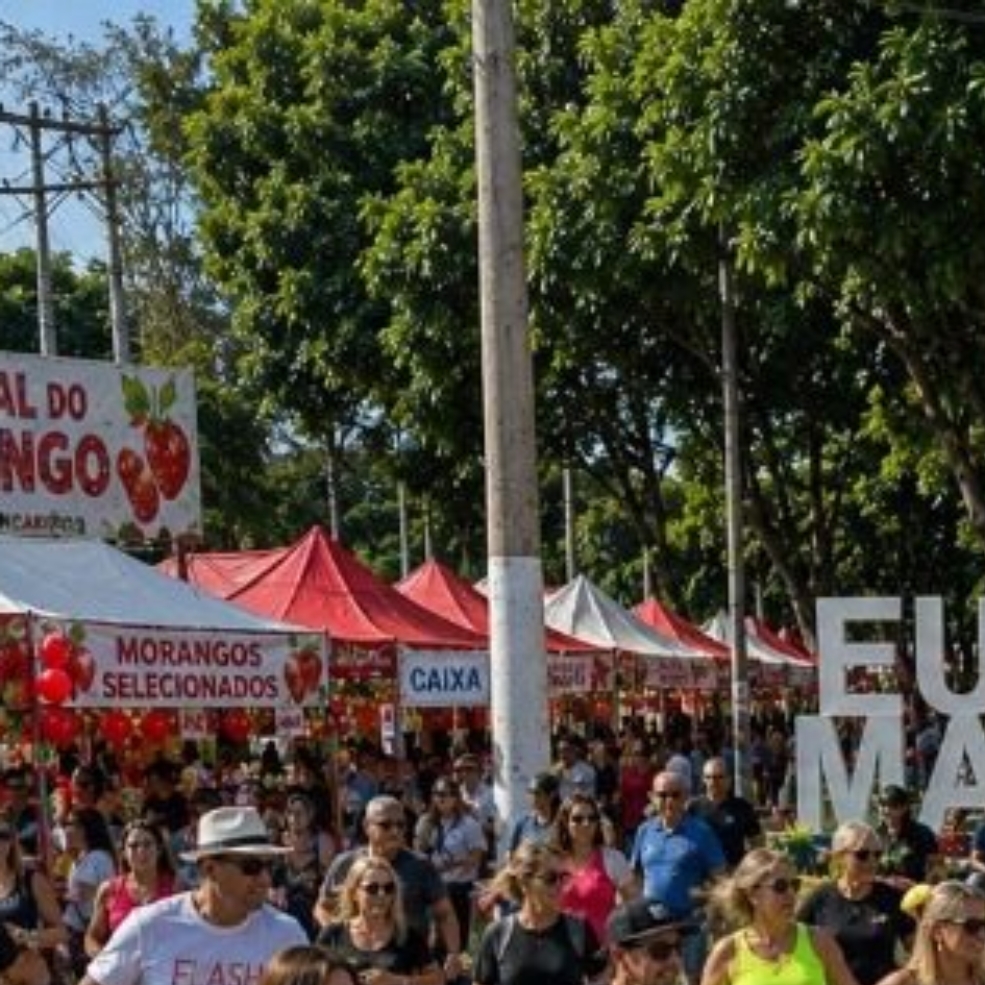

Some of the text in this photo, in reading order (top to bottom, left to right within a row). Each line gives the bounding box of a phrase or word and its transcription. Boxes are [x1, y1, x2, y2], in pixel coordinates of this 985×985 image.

[47, 382, 87, 422] DO
[117, 636, 263, 667] MORANGOS
[103, 671, 278, 698] SELECIONADOS
[409, 665, 482, 692] CAIXA
